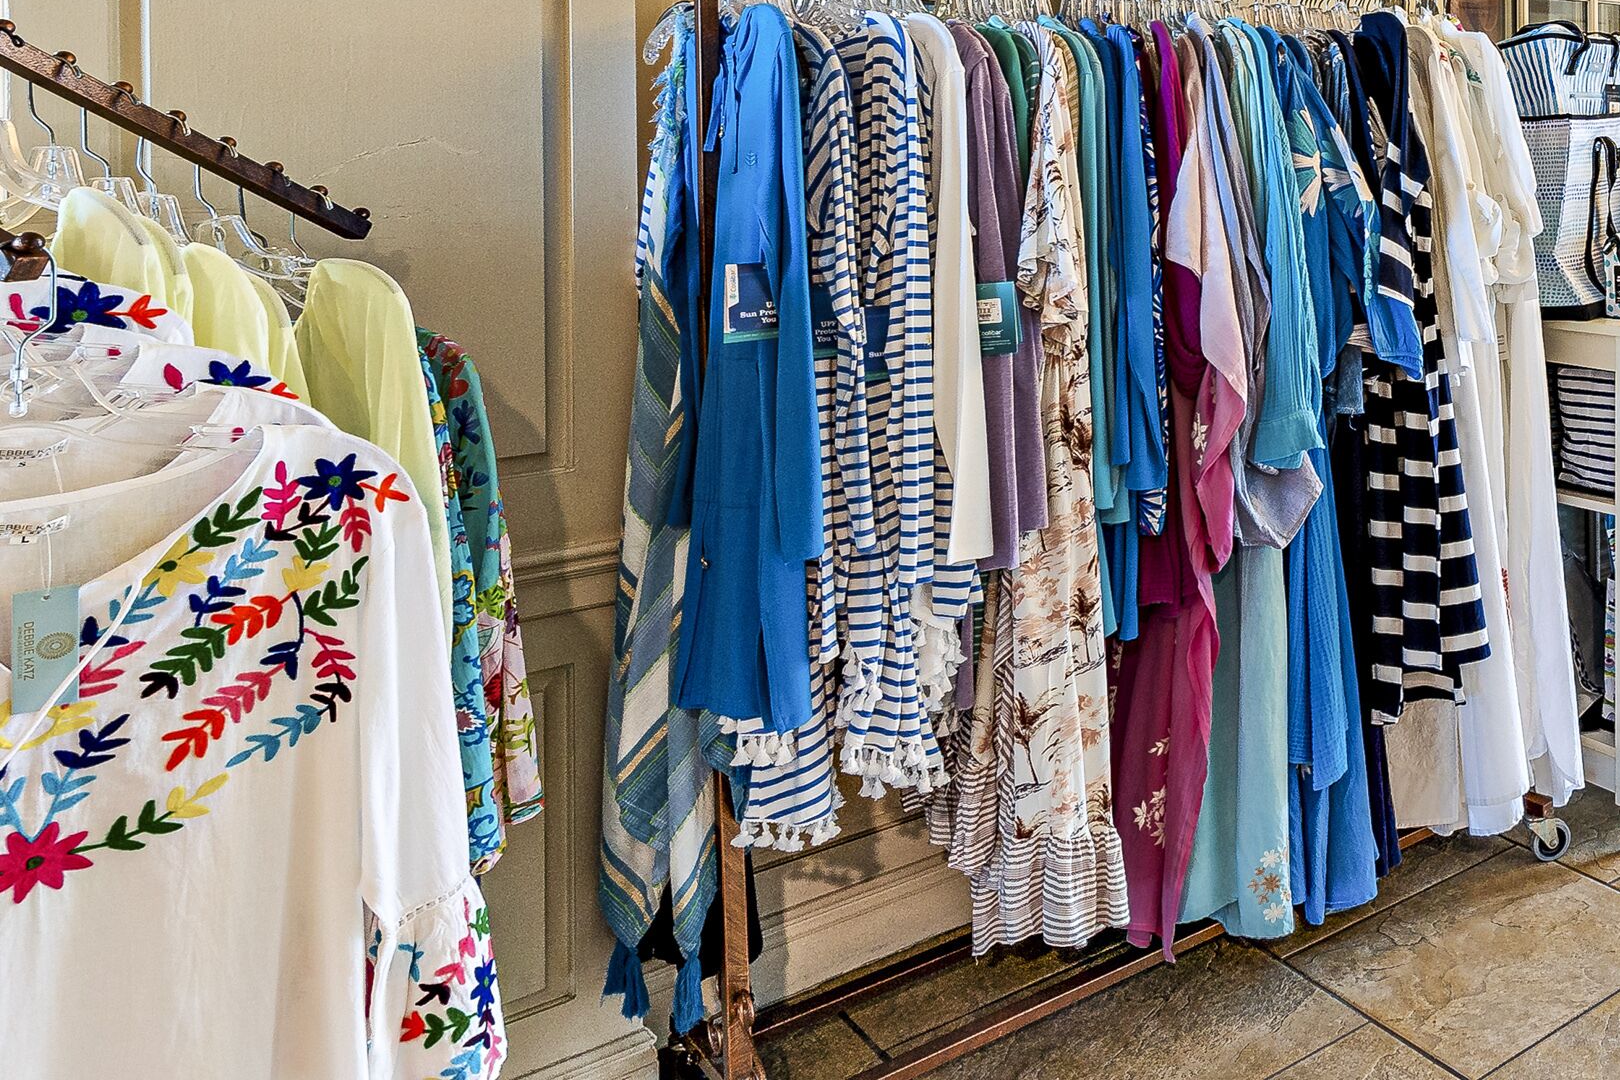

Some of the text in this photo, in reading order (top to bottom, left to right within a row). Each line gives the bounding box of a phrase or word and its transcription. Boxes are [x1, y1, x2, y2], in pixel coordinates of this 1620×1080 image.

[739, 311, 758, 319] Sun
[21, 535, 30, 544] L
[23, 621, 35, 681] DEBBIE KATZ
